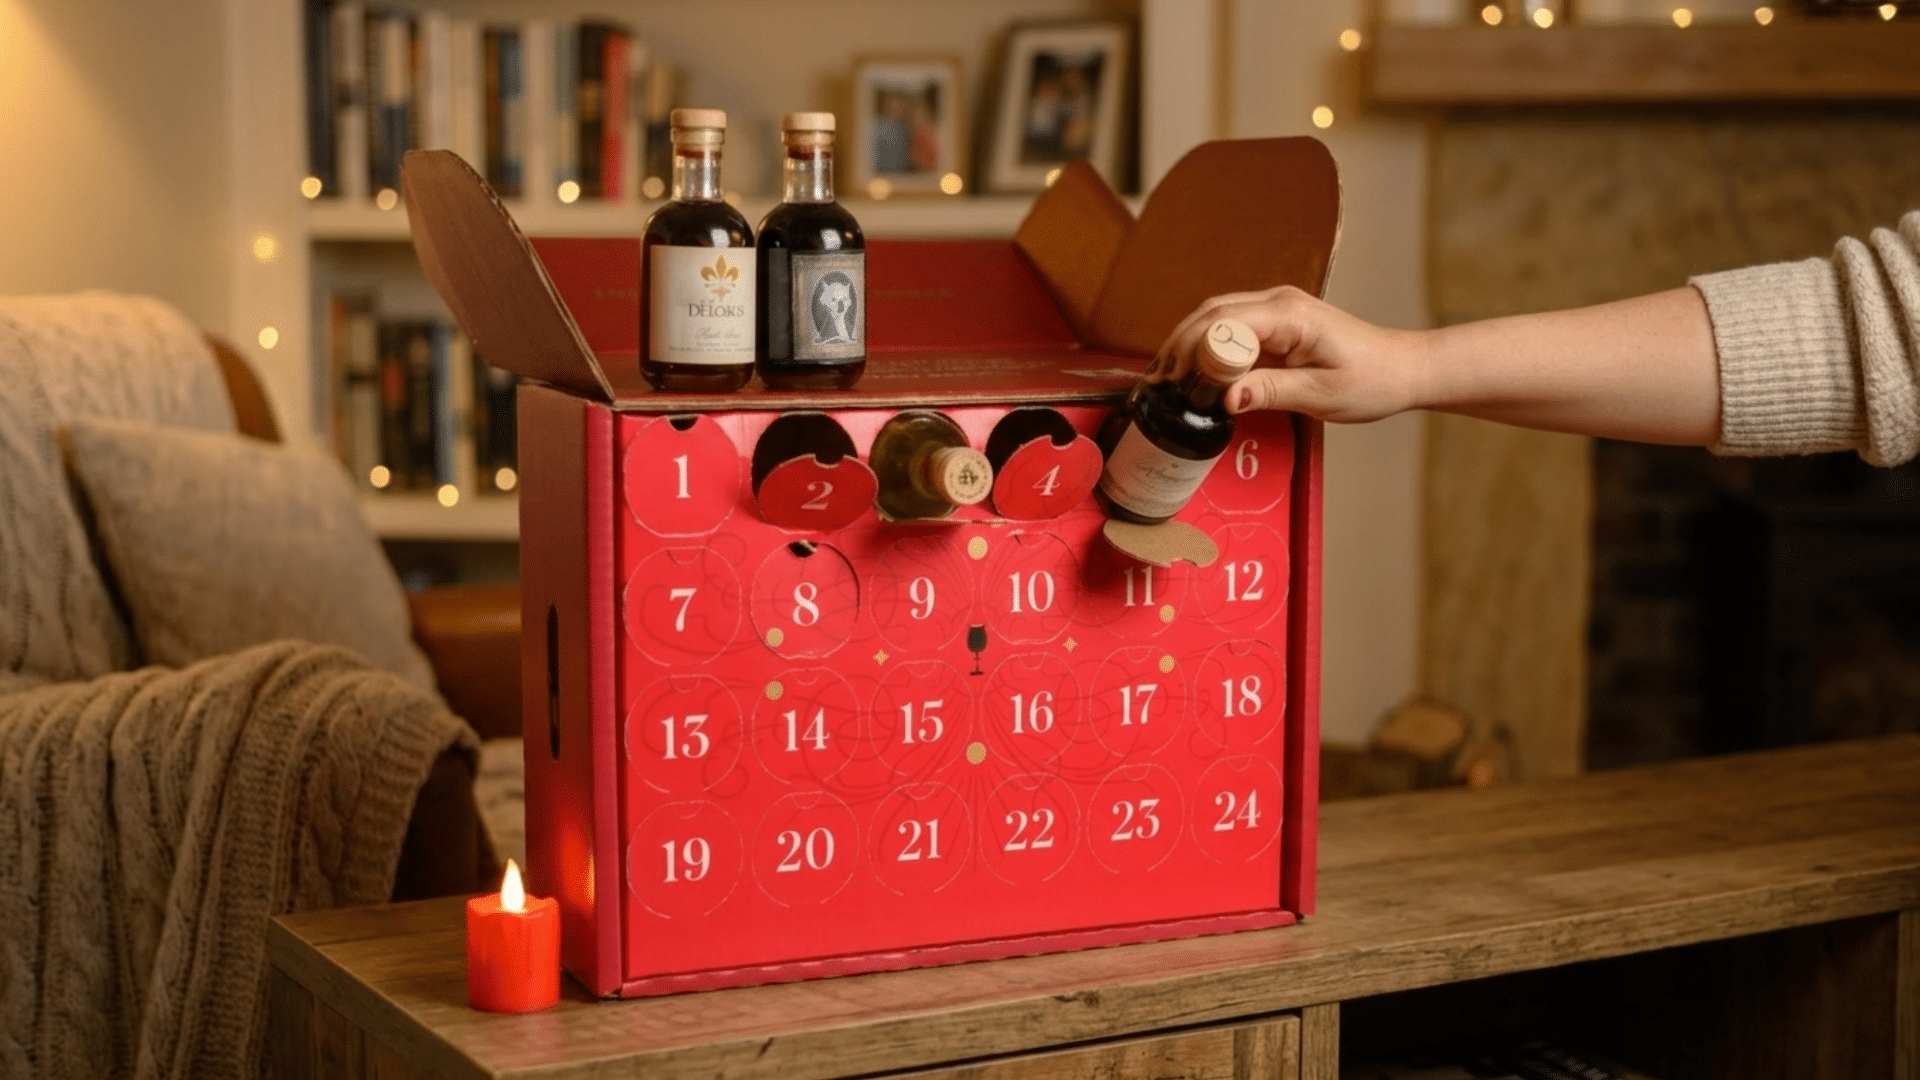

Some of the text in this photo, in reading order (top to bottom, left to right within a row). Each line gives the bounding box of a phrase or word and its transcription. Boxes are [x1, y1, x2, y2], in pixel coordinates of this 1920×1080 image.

[673, 454, 691, 499] 1
[1032, 464, 1060, 496] 4
[1236, 439, 1259, 480] 6
[800, 480, 834, 511] 2
[910, 578, 934, 618] 9
[1010, 572, 1054, 612] 10
[1123, 565, 1155, 607] 11
[1225, 561, 1263, 601] 12
[669, 588, 697, 632] 7
[793, 583, 819, 624] 8
[1012, 693, 1053, 733] 16
[1119, 683, 1158, 726] 17
[1223, 676, 1261, 716] 18
[663, 717, 709, 758] 13
[785, 709, 829, 751] 14
[901, 703, 943, 743] 15
[1004, 808, 1054, 851] 22
[1111, 798, 1160, 842] 23
[1213, 788, 1261, 832] 24
[664, 839, 710, 881] 19
[776, 827, 834, 872] 20
[897, 819, 940, 862] 21
